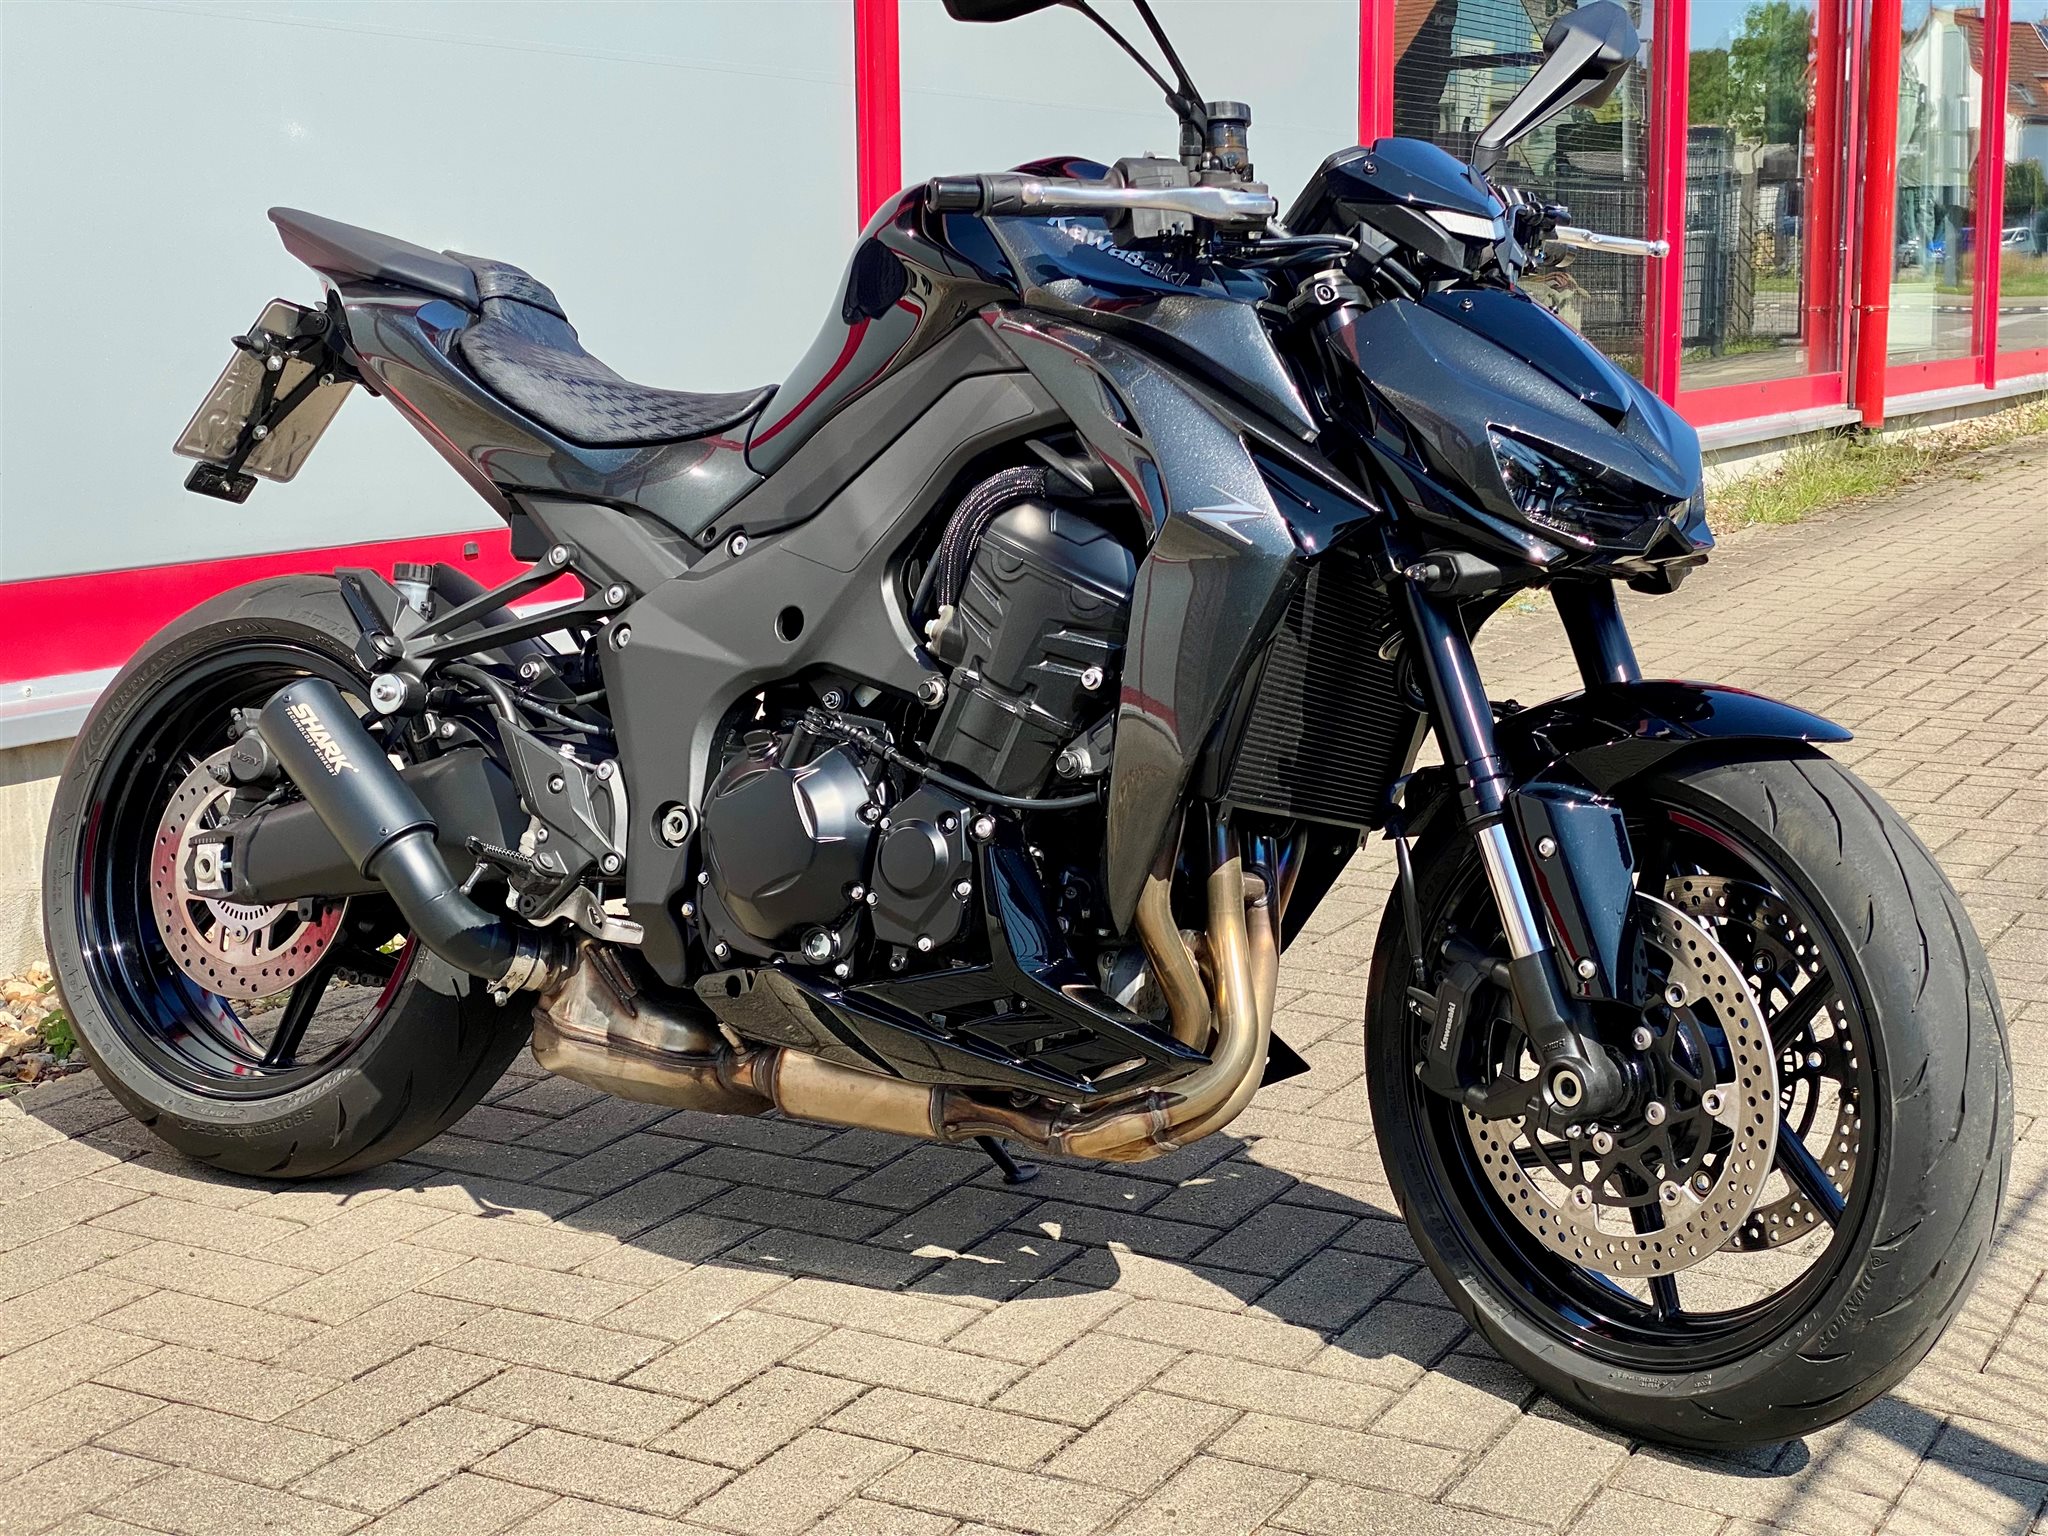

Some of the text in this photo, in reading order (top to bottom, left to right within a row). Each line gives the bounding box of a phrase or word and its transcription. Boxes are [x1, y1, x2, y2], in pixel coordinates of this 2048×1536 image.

[1046, 216, 1190, 287] Kawasaki
[284, 706, 338, 777] TECHNOLOGY EXHAUST
[289, 703, 359, 775] SHARK
[1439, 1001, 1457, 1051] Kawasaki
